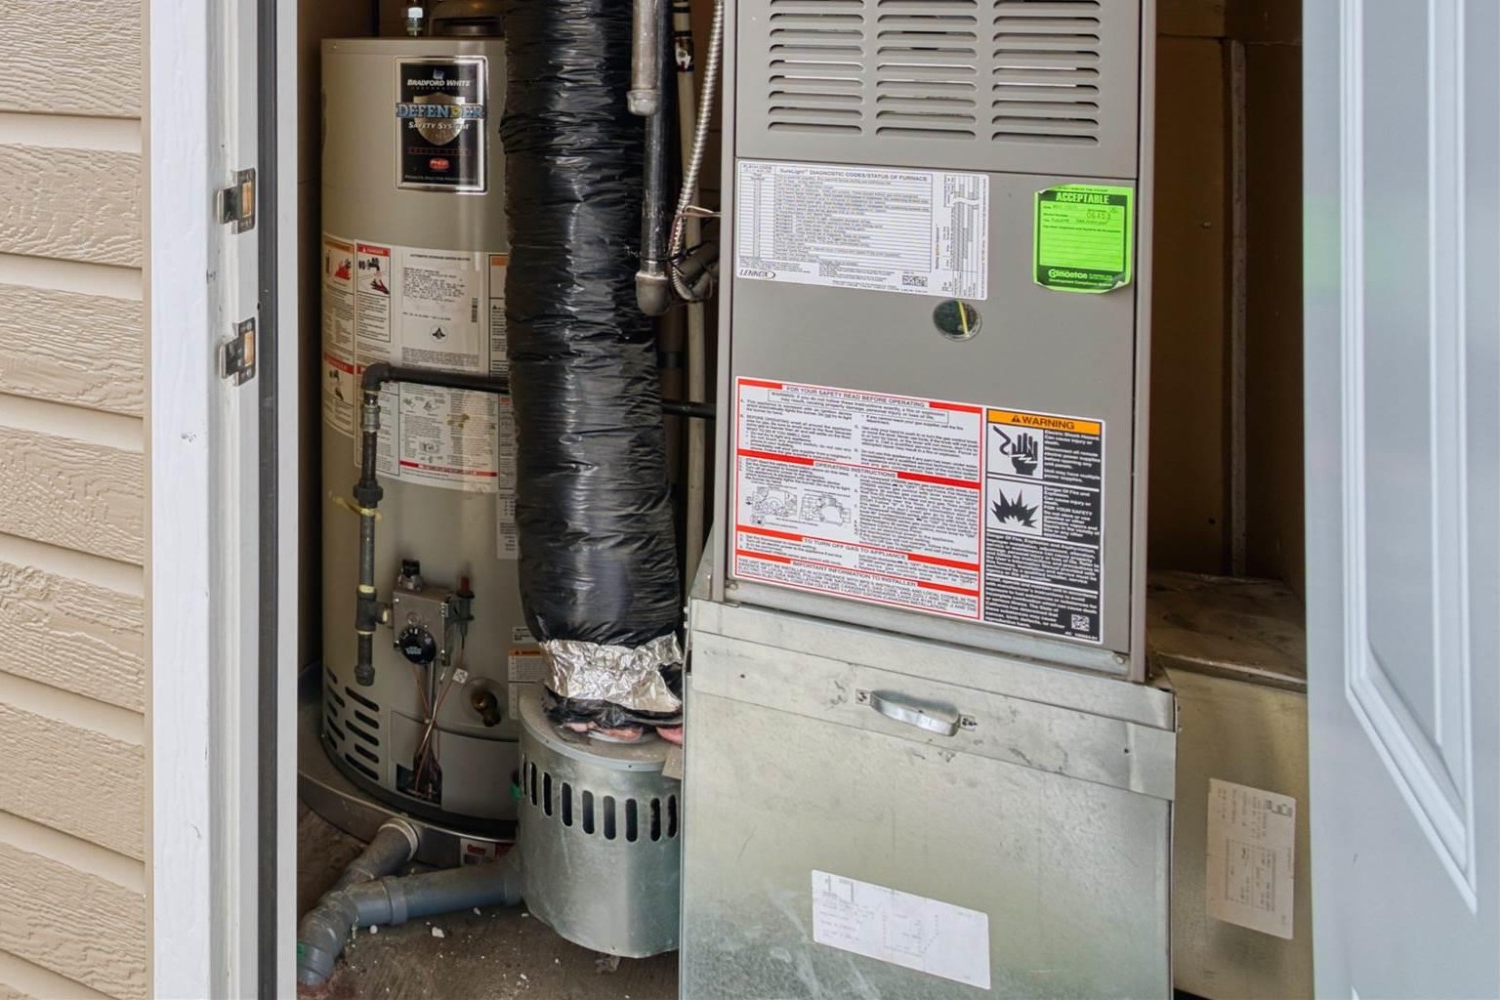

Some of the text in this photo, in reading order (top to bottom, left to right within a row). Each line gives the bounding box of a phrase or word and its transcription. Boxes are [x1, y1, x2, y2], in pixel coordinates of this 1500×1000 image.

[399, 105, 483, 118] DEFENDER
[1056, 192, 1110, 204] ACCEPTABLE
[862, 395, 887, 403] BEFORE
[889, 399, 926, 408] OPERATING
[1021, 416, 1075, 430] WARNING
